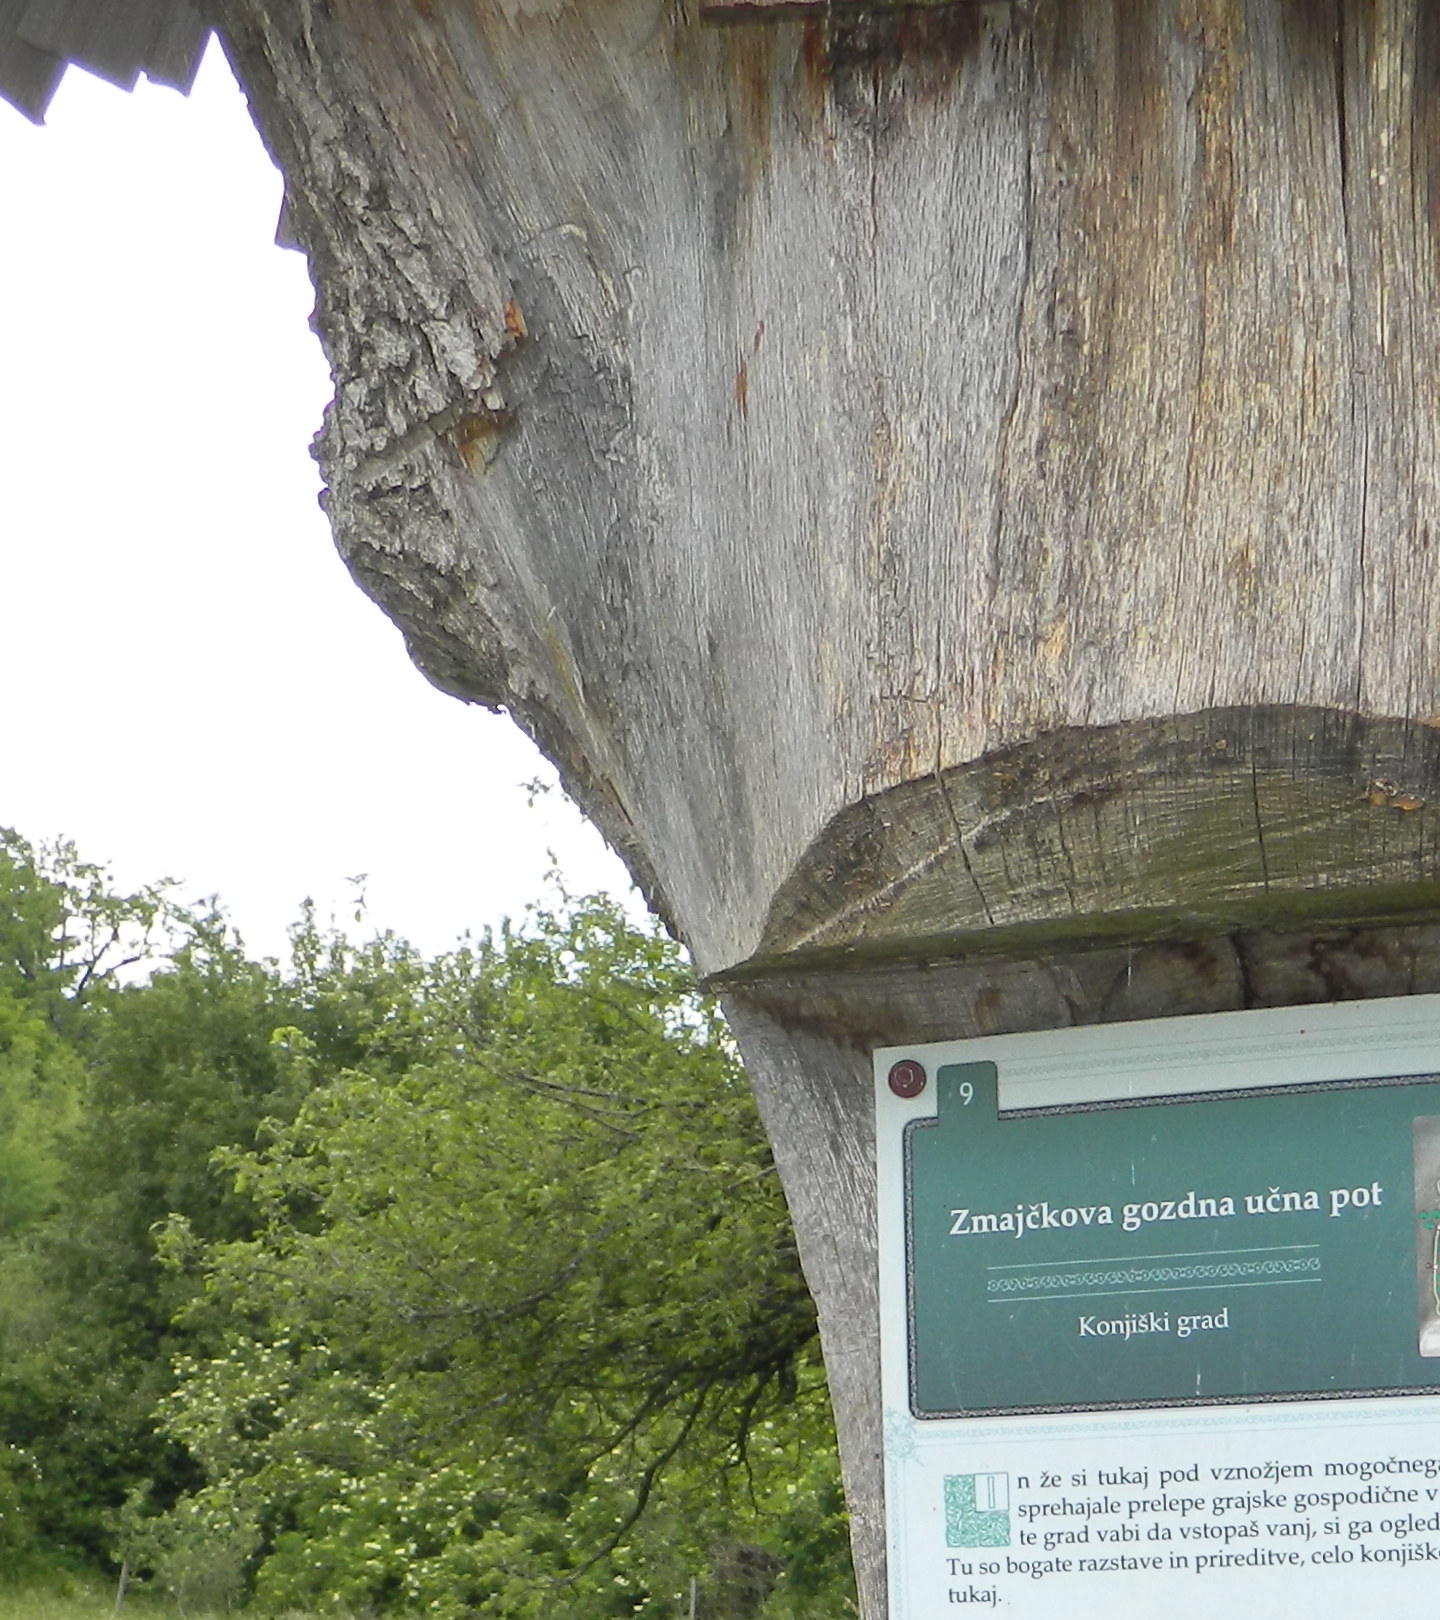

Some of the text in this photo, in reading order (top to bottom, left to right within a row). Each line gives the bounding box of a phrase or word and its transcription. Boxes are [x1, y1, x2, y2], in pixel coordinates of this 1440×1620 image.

[959, 1081, 974, 1106] 9
[949, 1181, 1383, 1239] Zmajčkova gozdna učna pot
[1079, 1307, 1230, 1341] Konjiški grad
[1210, 1460, 1314, 1485] vznožjem
[1017, 1495, 1122, 1524] sprehajale
[1127, 1492, 1206, 1520] prelepe
[1211, 1489, 1287, 1516] grajske
[1293, 1484, 1419, 1513] gospodične
[1178, 1519, 1260, 1545] vstopaš
[1005, 1555, 1073, 1580] bogate
[1078, 1554, 1164, 1572] razstave
[1195, 1547, 1306, 1575] prireditve,
